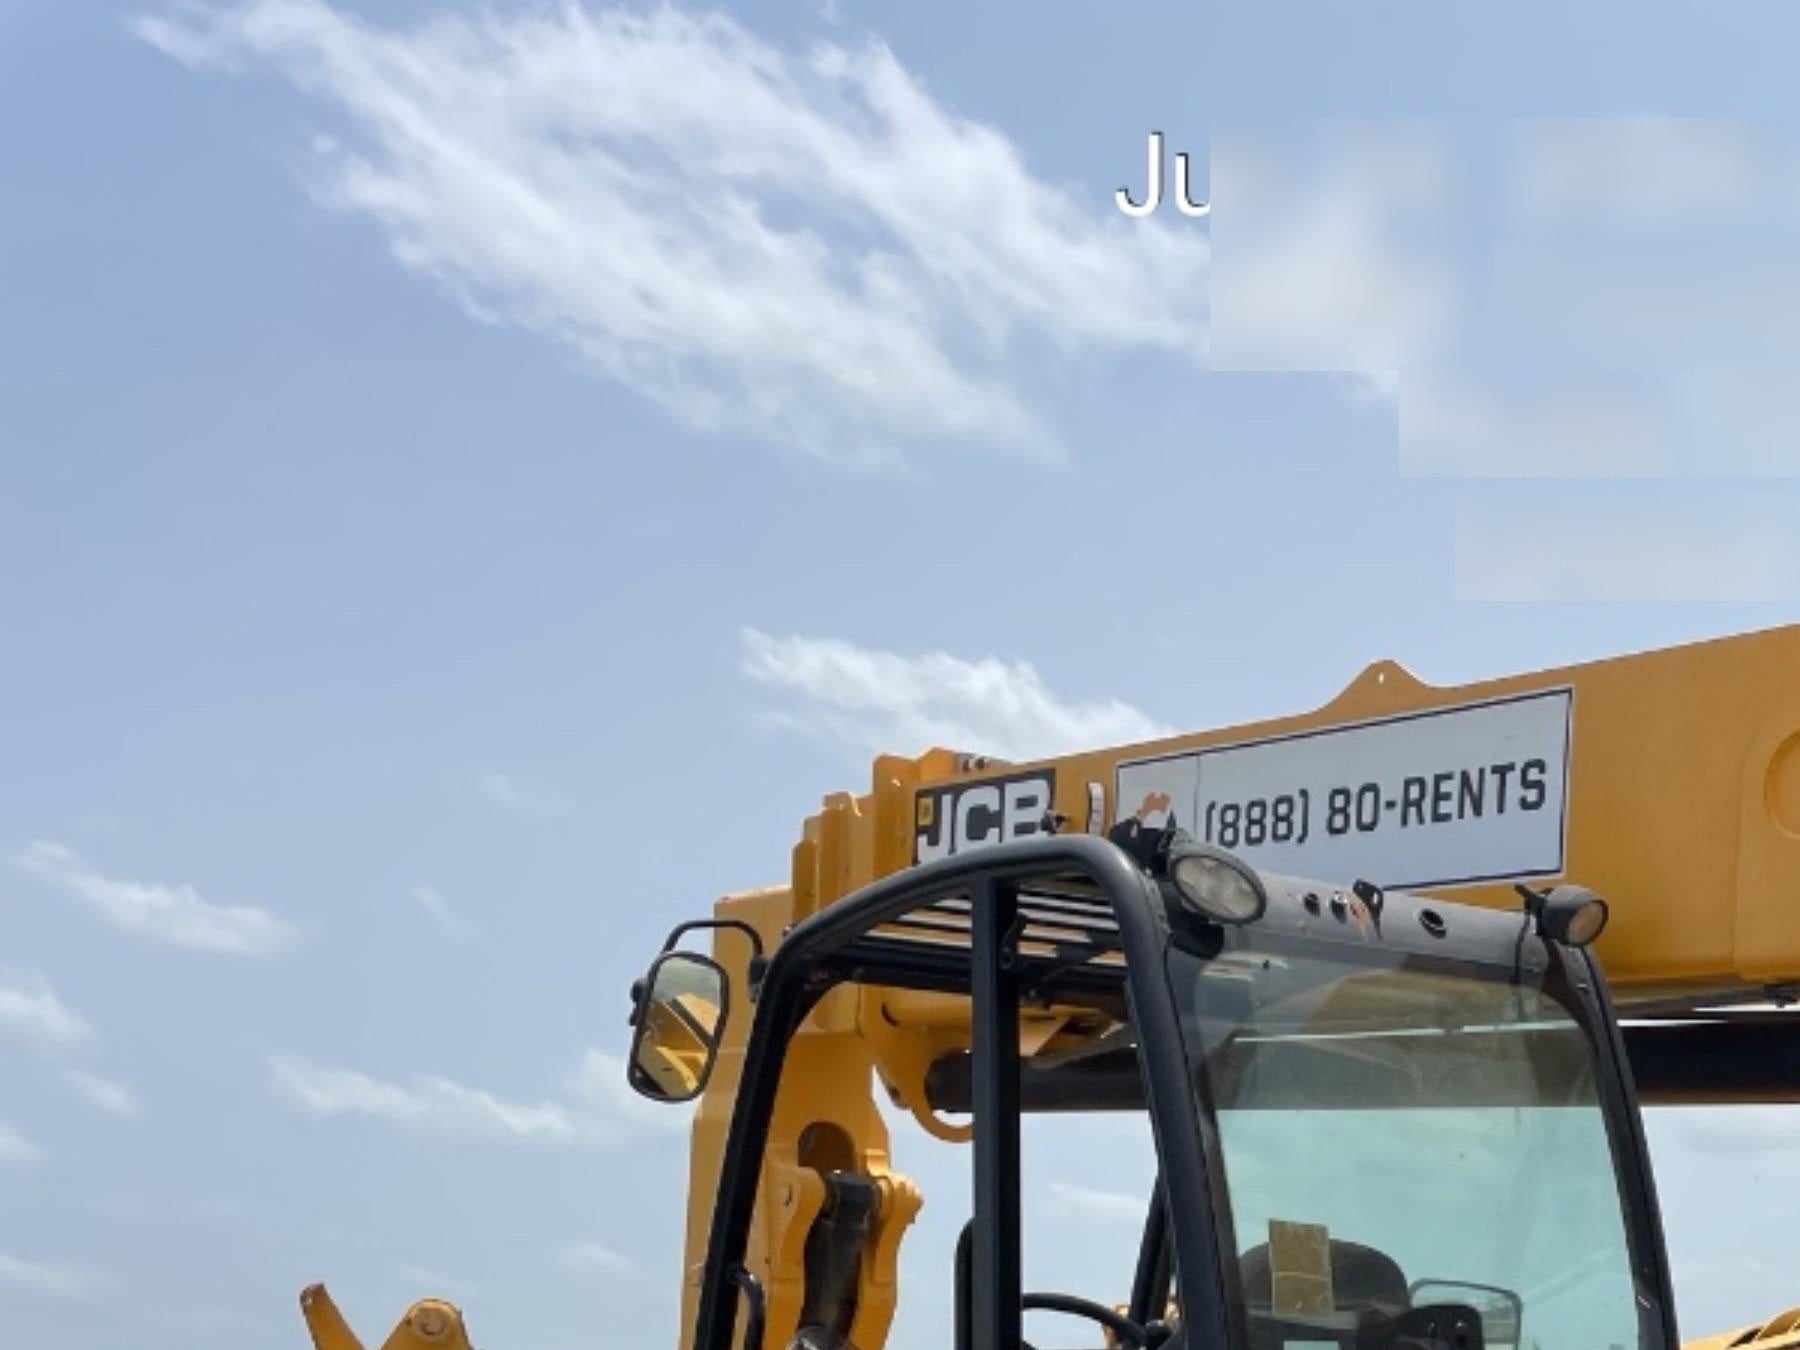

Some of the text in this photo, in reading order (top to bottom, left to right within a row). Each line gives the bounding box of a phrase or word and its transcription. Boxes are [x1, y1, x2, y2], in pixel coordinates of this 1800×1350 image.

[918, 778, 1050, 863] JCB
[1204, 757, 1547, 850] (888) 80-RENTS
